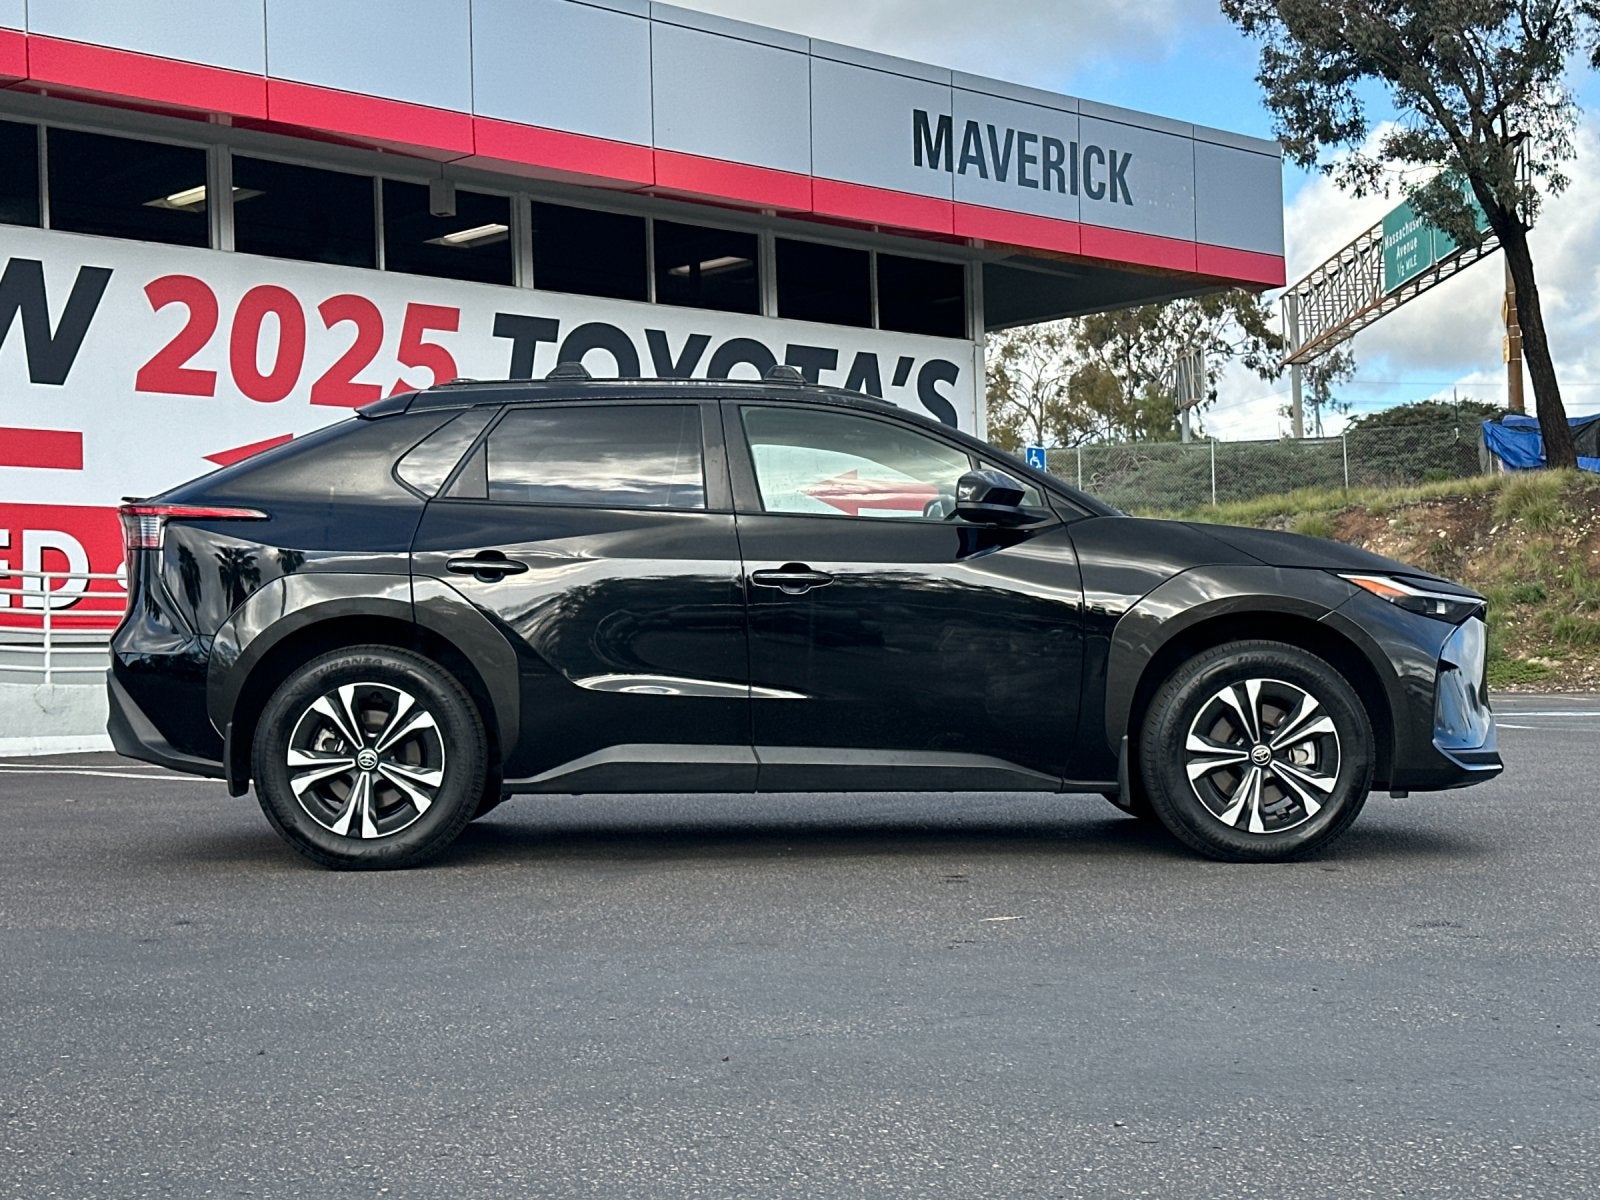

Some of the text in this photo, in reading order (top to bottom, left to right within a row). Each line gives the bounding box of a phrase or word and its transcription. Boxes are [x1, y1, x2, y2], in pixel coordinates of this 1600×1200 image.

[913, 108, 1133, 206] MAVERICK
[1397, 237, 1417, 260] Avenue
[1406, 254, 1417, 271] MILE
[134, 275, 461, 408] 2025
